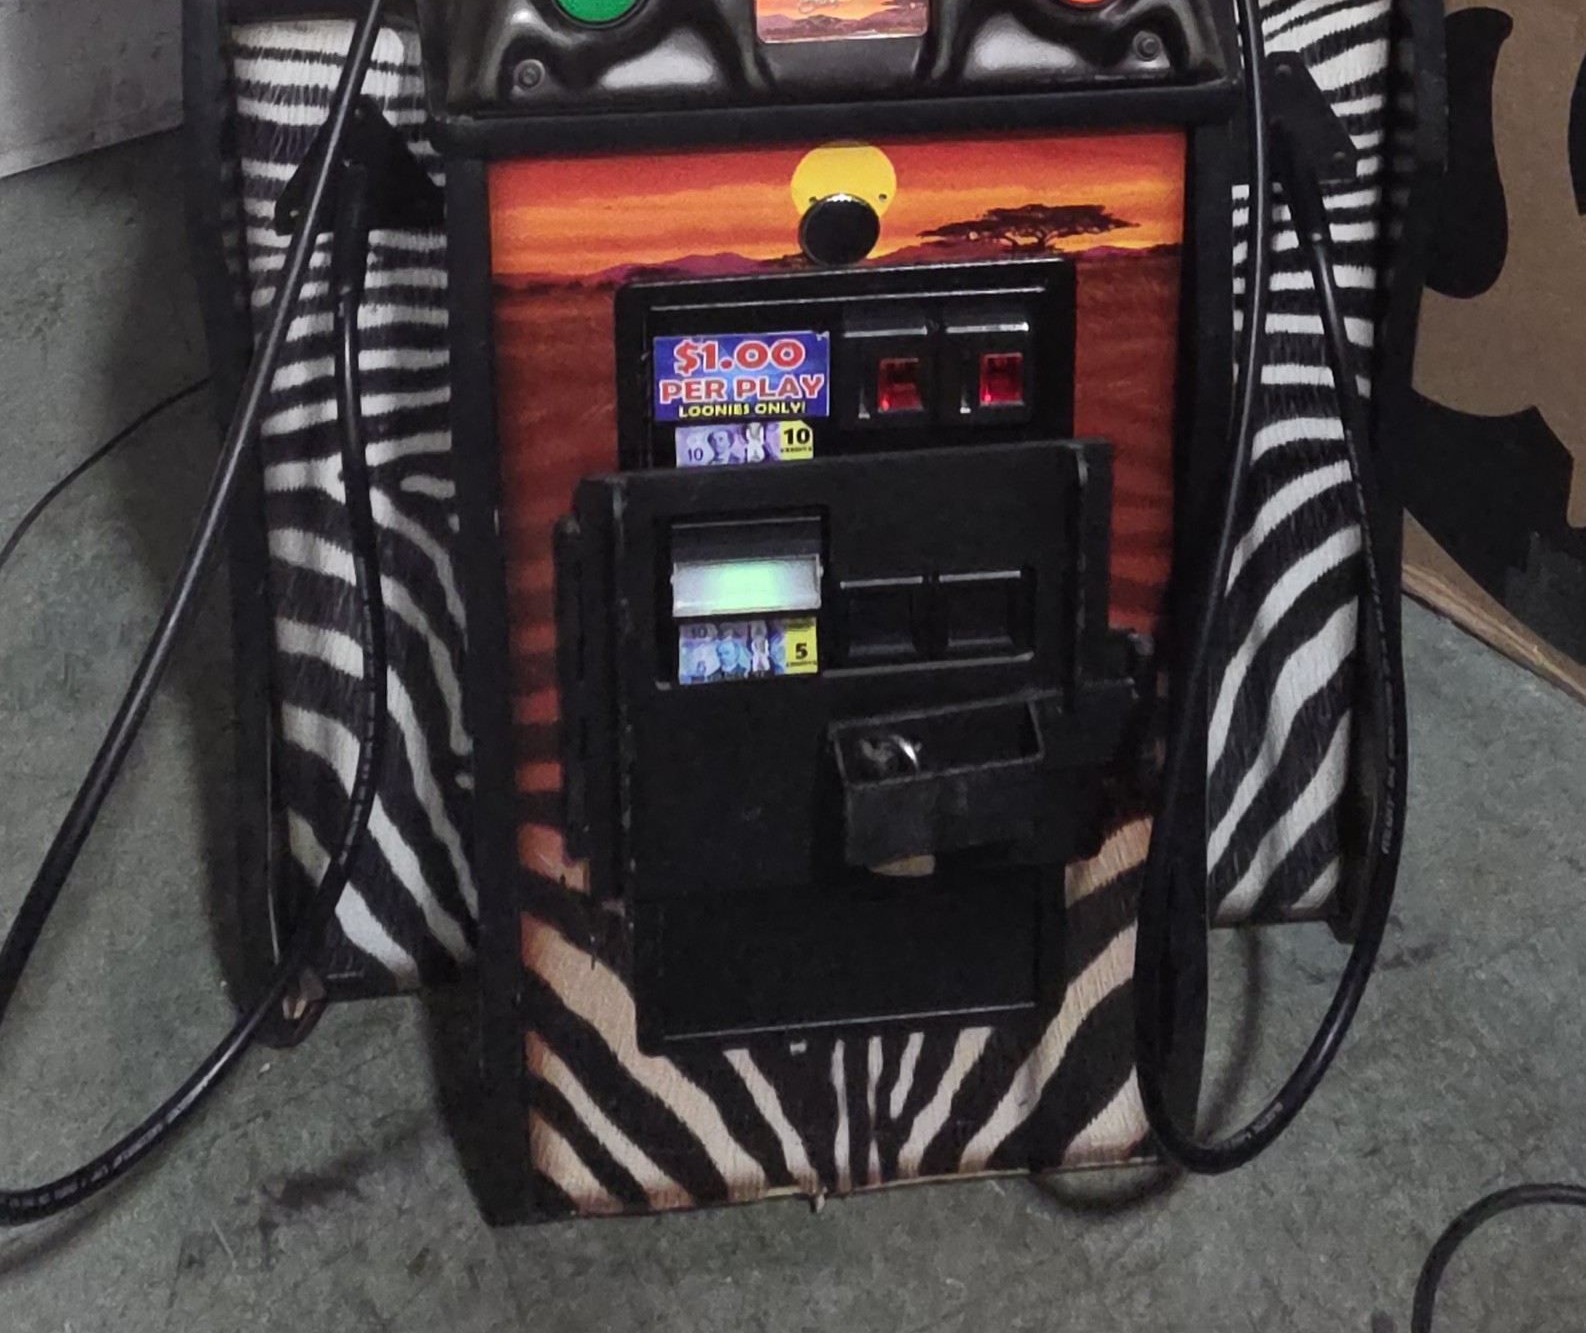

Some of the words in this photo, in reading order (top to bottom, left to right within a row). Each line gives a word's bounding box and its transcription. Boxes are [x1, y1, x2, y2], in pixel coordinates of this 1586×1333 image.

[673, 338, 806, 377] $1.00
[659, 377, 726, 404] PER
[734, 374, 825, 402] PLAY
[679, 403, 750, 418] LOONIES
[754, 400, 806, 414] ONLY!
[784, 428, 811, 445] 10
[687, 448, 704, 461] 10
[795, 642, 808, 661] 5
